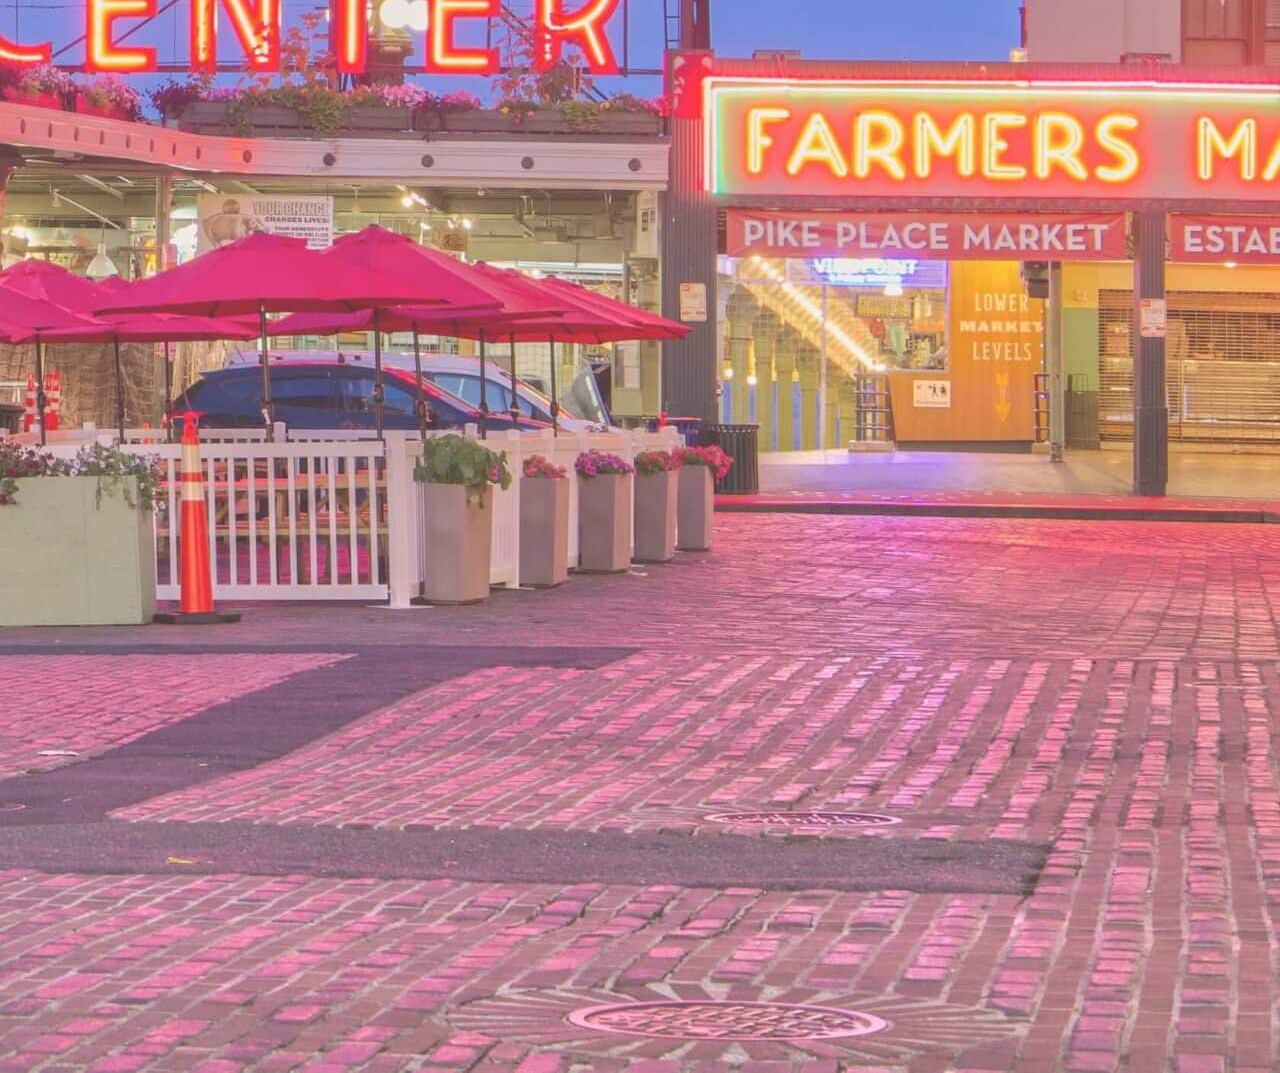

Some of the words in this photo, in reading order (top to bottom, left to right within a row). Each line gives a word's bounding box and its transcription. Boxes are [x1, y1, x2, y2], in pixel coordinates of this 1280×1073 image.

[747, 108, 1139, 181] FARMERS
[744, 220, 821, 248] PIKE
[836, 221, 949, 250] PLACE
[963, 222, 1109, 252] MARKET
[975, 293, 1029, 311] LOWER
[960, 321, 1042, 333] MARKET
[973, 342, 1032, 361] LEVELS
